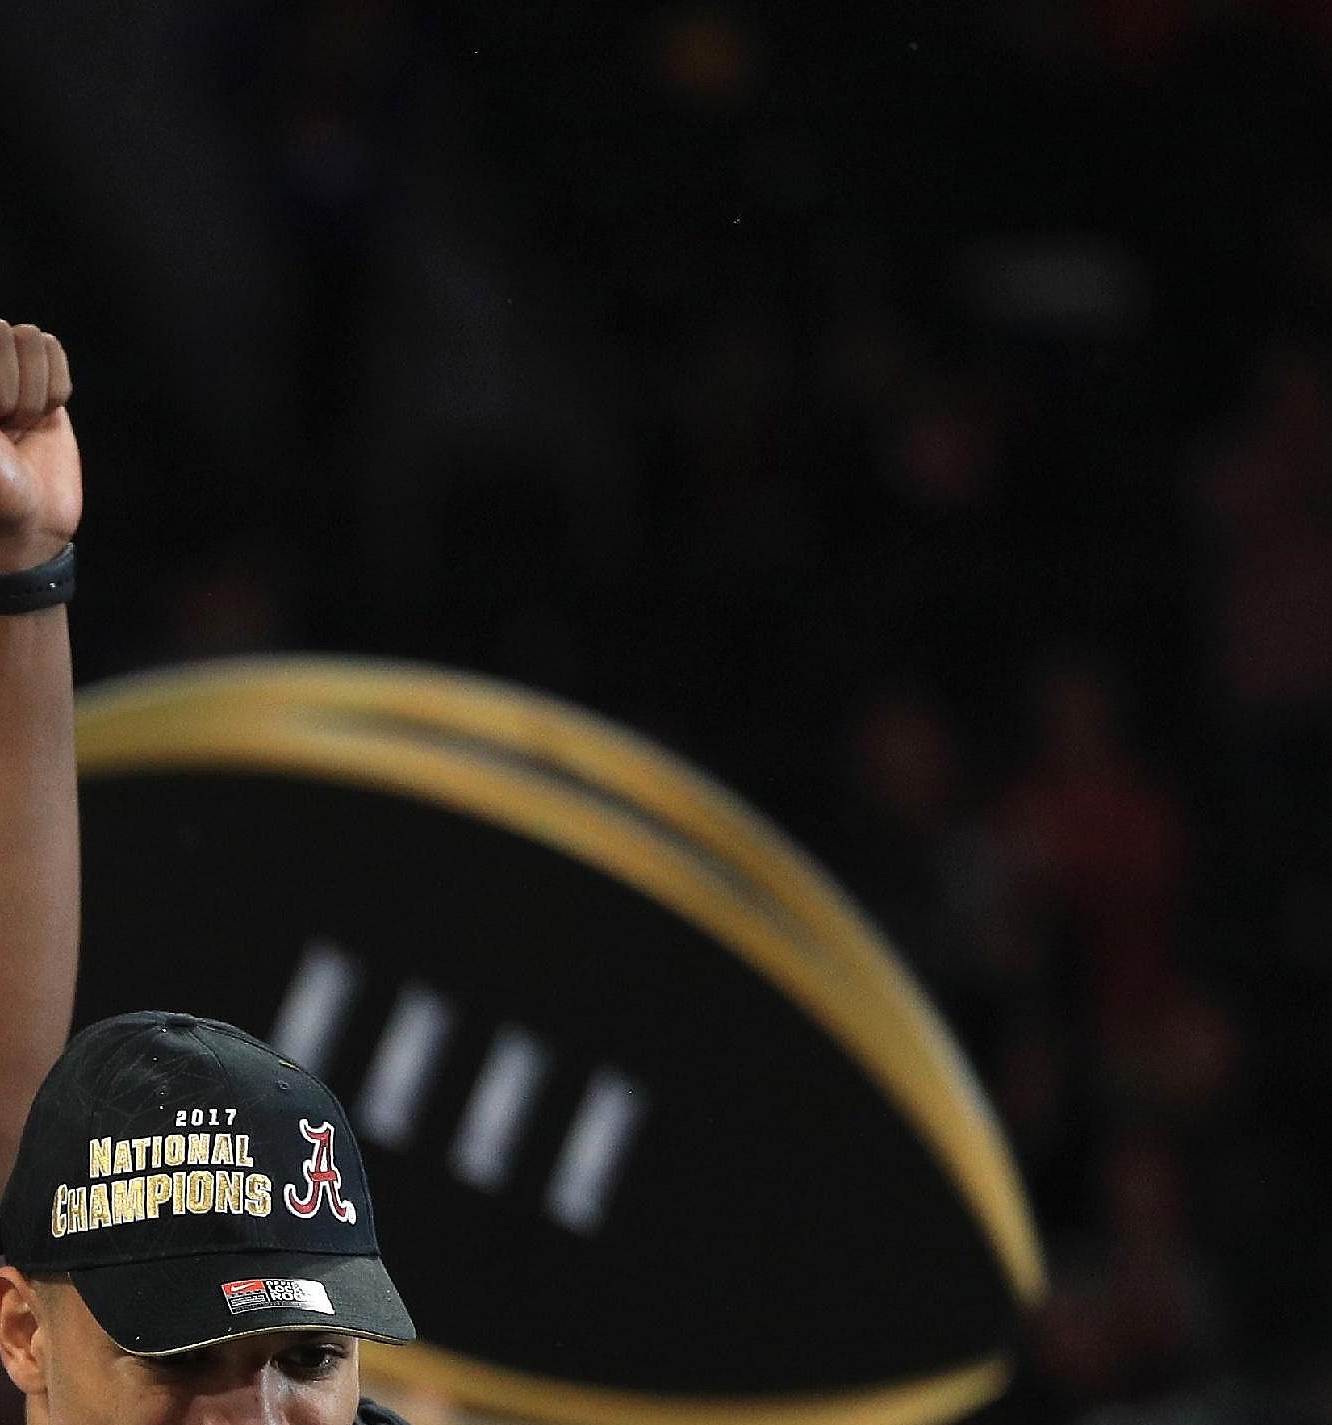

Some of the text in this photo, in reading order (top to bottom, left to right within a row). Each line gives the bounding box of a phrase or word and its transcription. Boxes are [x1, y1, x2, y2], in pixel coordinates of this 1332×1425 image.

[175, 1108, 237, 1126] 2017
[89, 1133, 254, 1179] NATIONAL
[51, 1170, 273, 1238] CHAMPIONS
